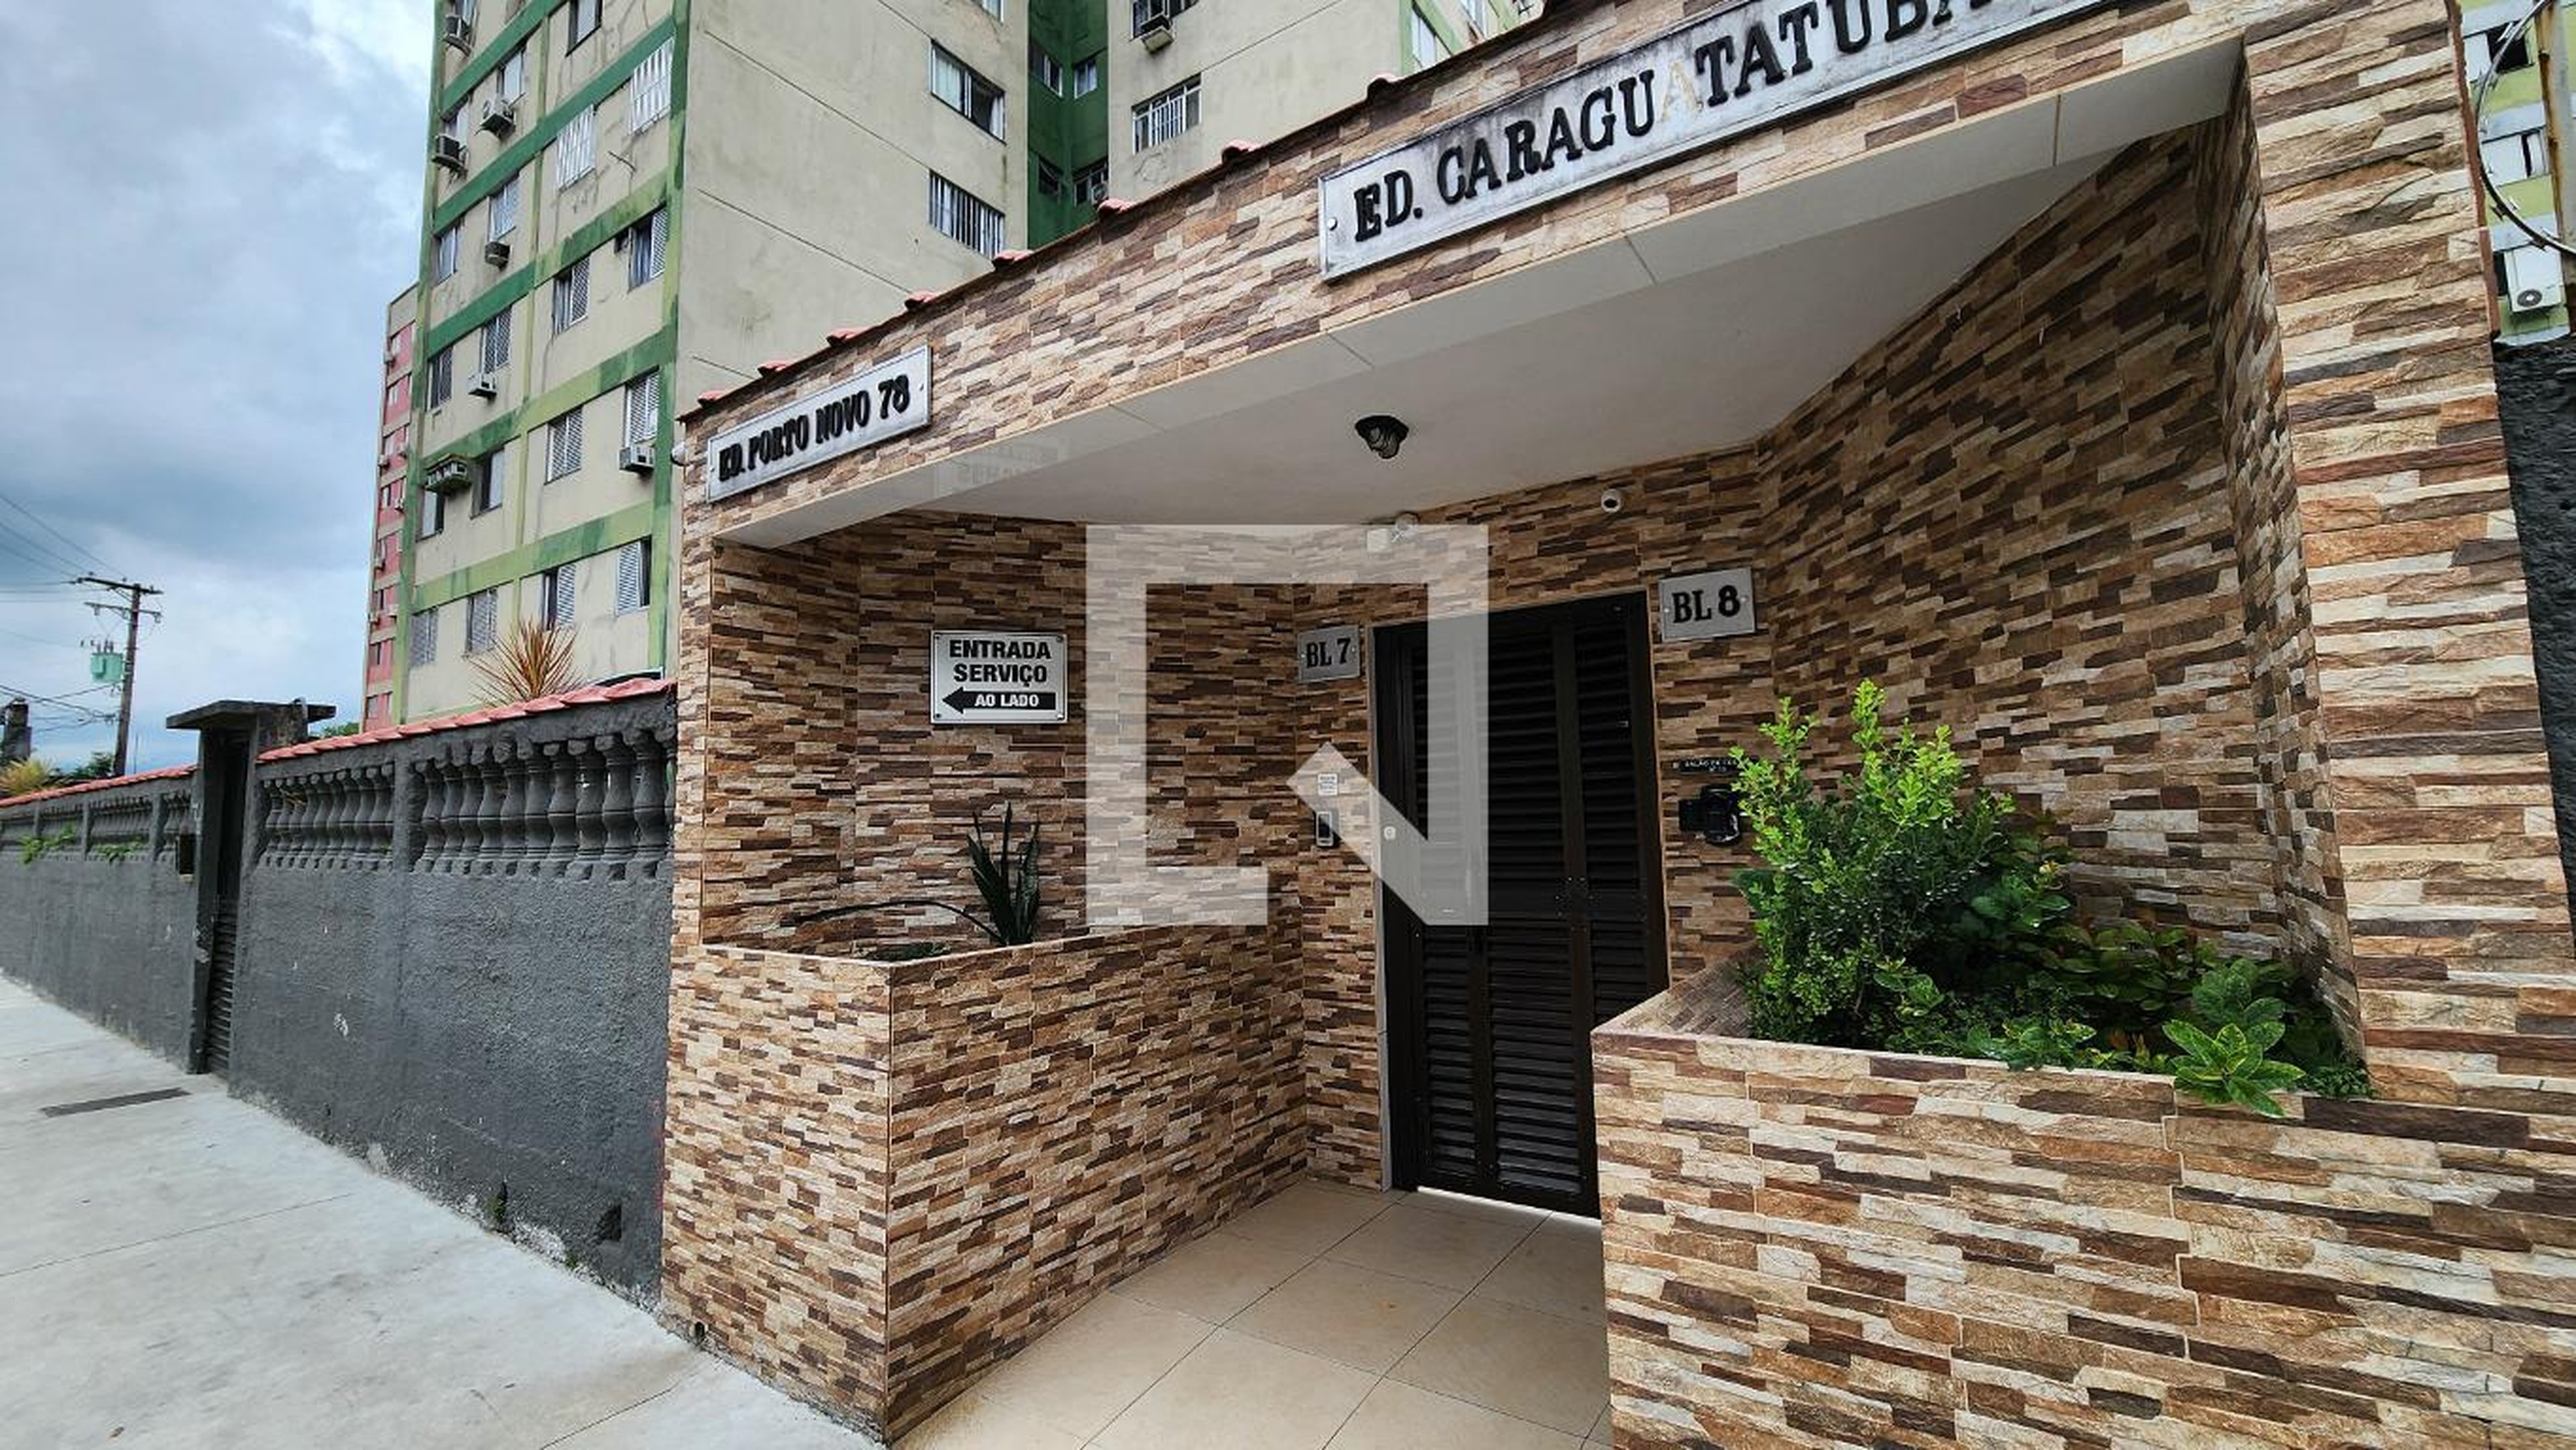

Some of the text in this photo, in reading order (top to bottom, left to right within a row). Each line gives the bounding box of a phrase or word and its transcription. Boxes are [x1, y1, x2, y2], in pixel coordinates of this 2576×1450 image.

[1354, 169, 1423, 242] ED.
[719, 374, 910, 482] ED. PORTO NOVO 78
[1672, 585, 1740, 623] BL 8
[949, 640, 1052, 659] ENTRADA
[1306, 637, 1351, 669] BL 7
[953, 663, 1047, 687] SERVIÇO
[975, 693, 1039, 707] AO LADO
